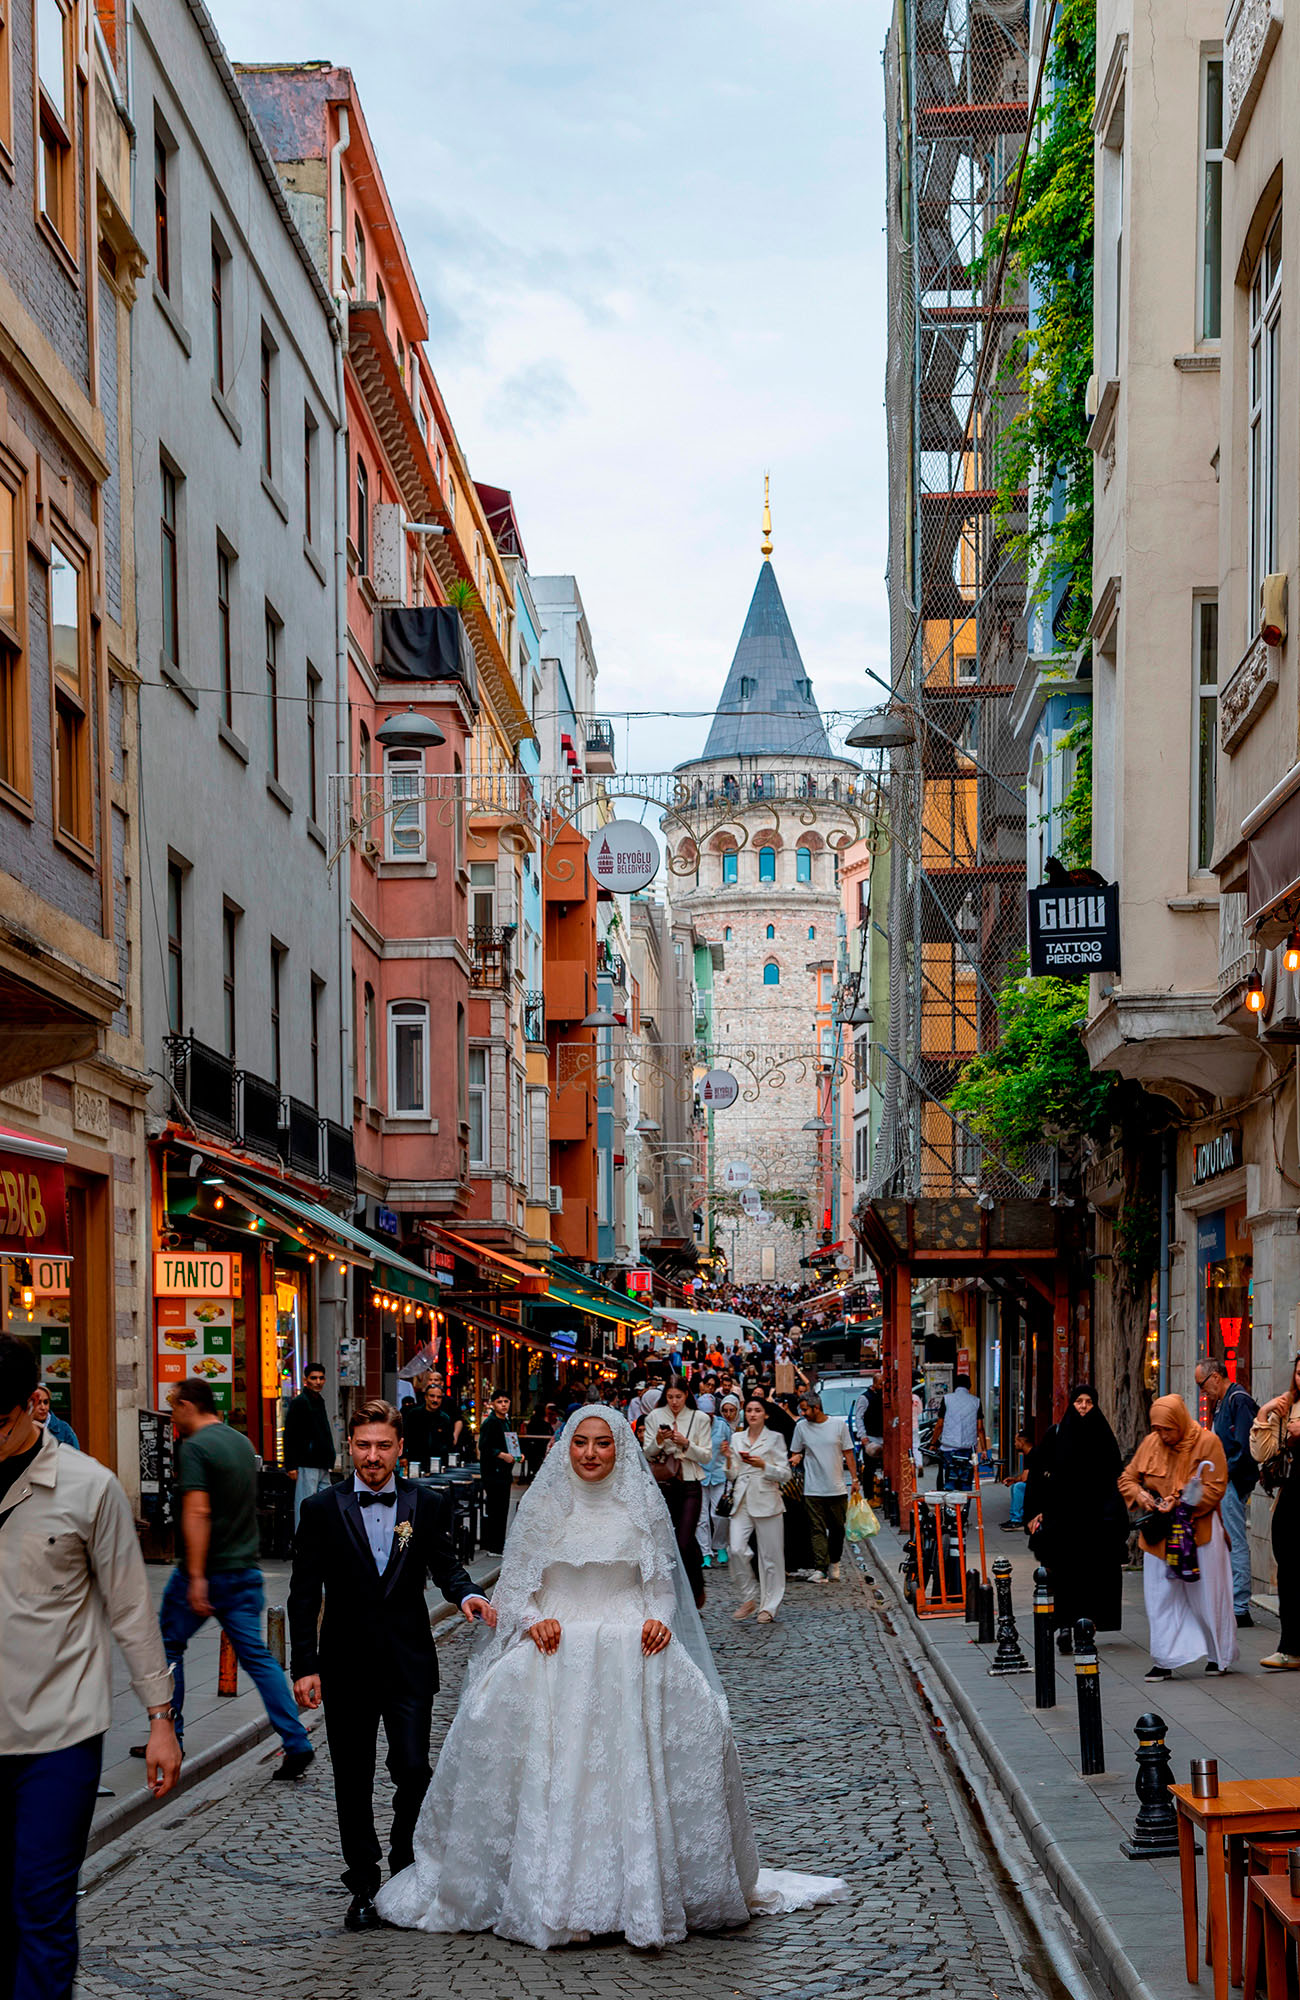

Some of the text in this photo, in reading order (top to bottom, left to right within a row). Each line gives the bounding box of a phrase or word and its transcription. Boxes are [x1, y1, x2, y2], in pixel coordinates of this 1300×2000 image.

[617, 850, 651, 864] BEYOĞLU
[1046, 941, 1102, 953] TATTOO
[1046, 953, 1102, 964] PIERCING
[164, 1261, 223, 1288] TANTO
